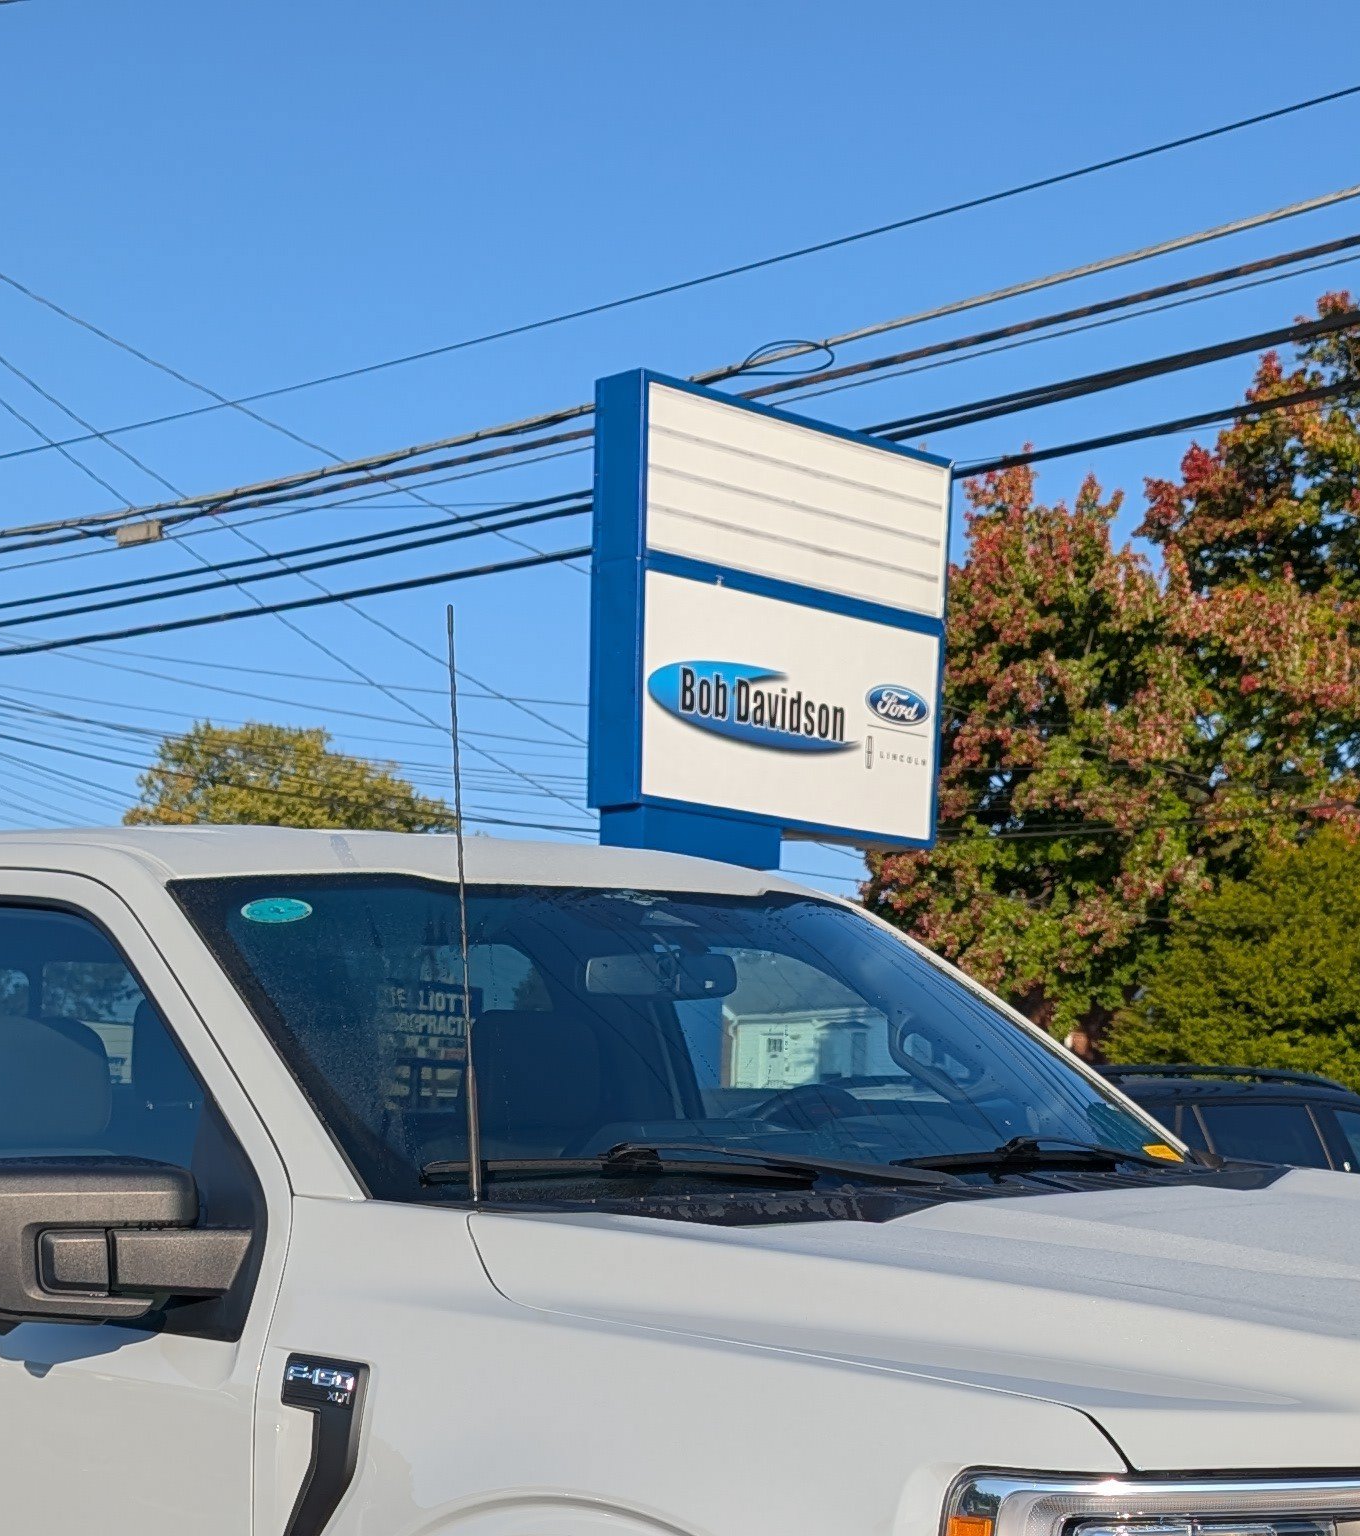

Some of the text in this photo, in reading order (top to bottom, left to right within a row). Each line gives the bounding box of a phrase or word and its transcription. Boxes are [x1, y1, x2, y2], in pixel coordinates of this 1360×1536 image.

[680, 666, 846, 742] Bob Davidson
[876, 688, 919, 721] Ford
[879, 750, 928, 766] LINCOLN
